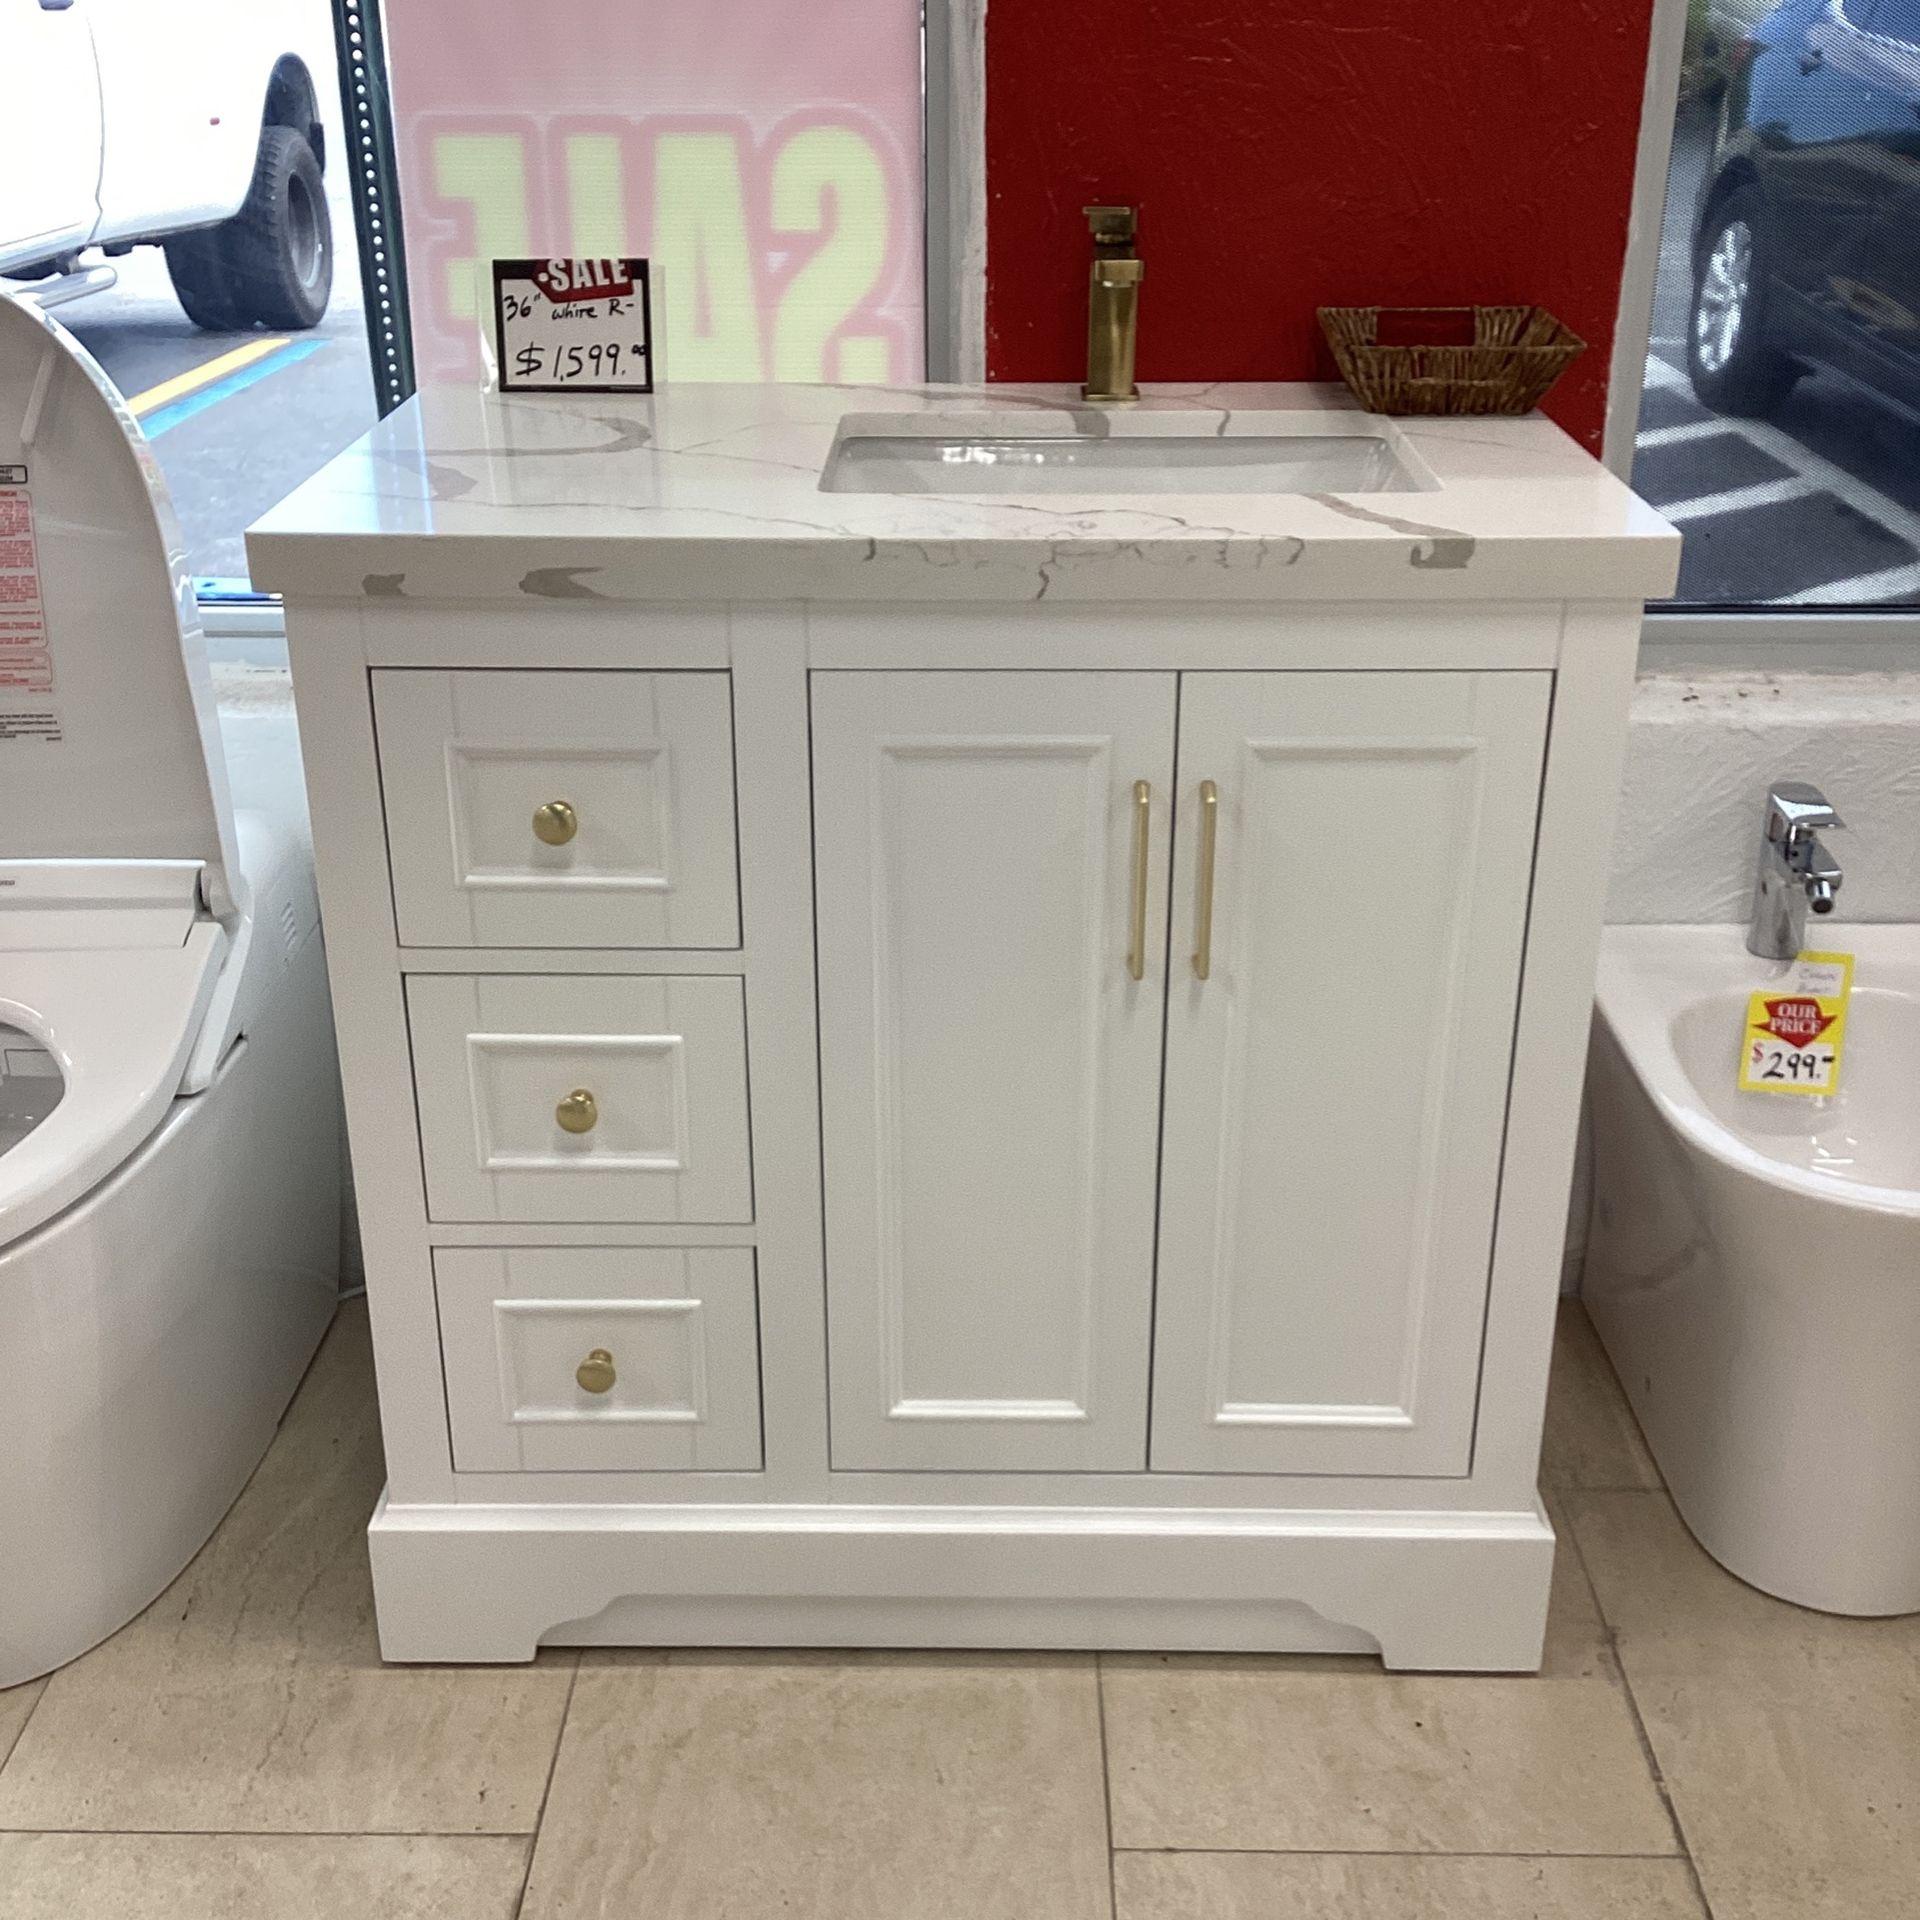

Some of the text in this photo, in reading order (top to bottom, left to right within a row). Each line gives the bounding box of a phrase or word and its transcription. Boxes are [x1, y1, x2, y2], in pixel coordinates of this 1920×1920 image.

[548, 258, 628, 291] SALE
[1778, 1003, 1816, 1018] OUR
[1770, 1017, 1821, 1034] PRICE
